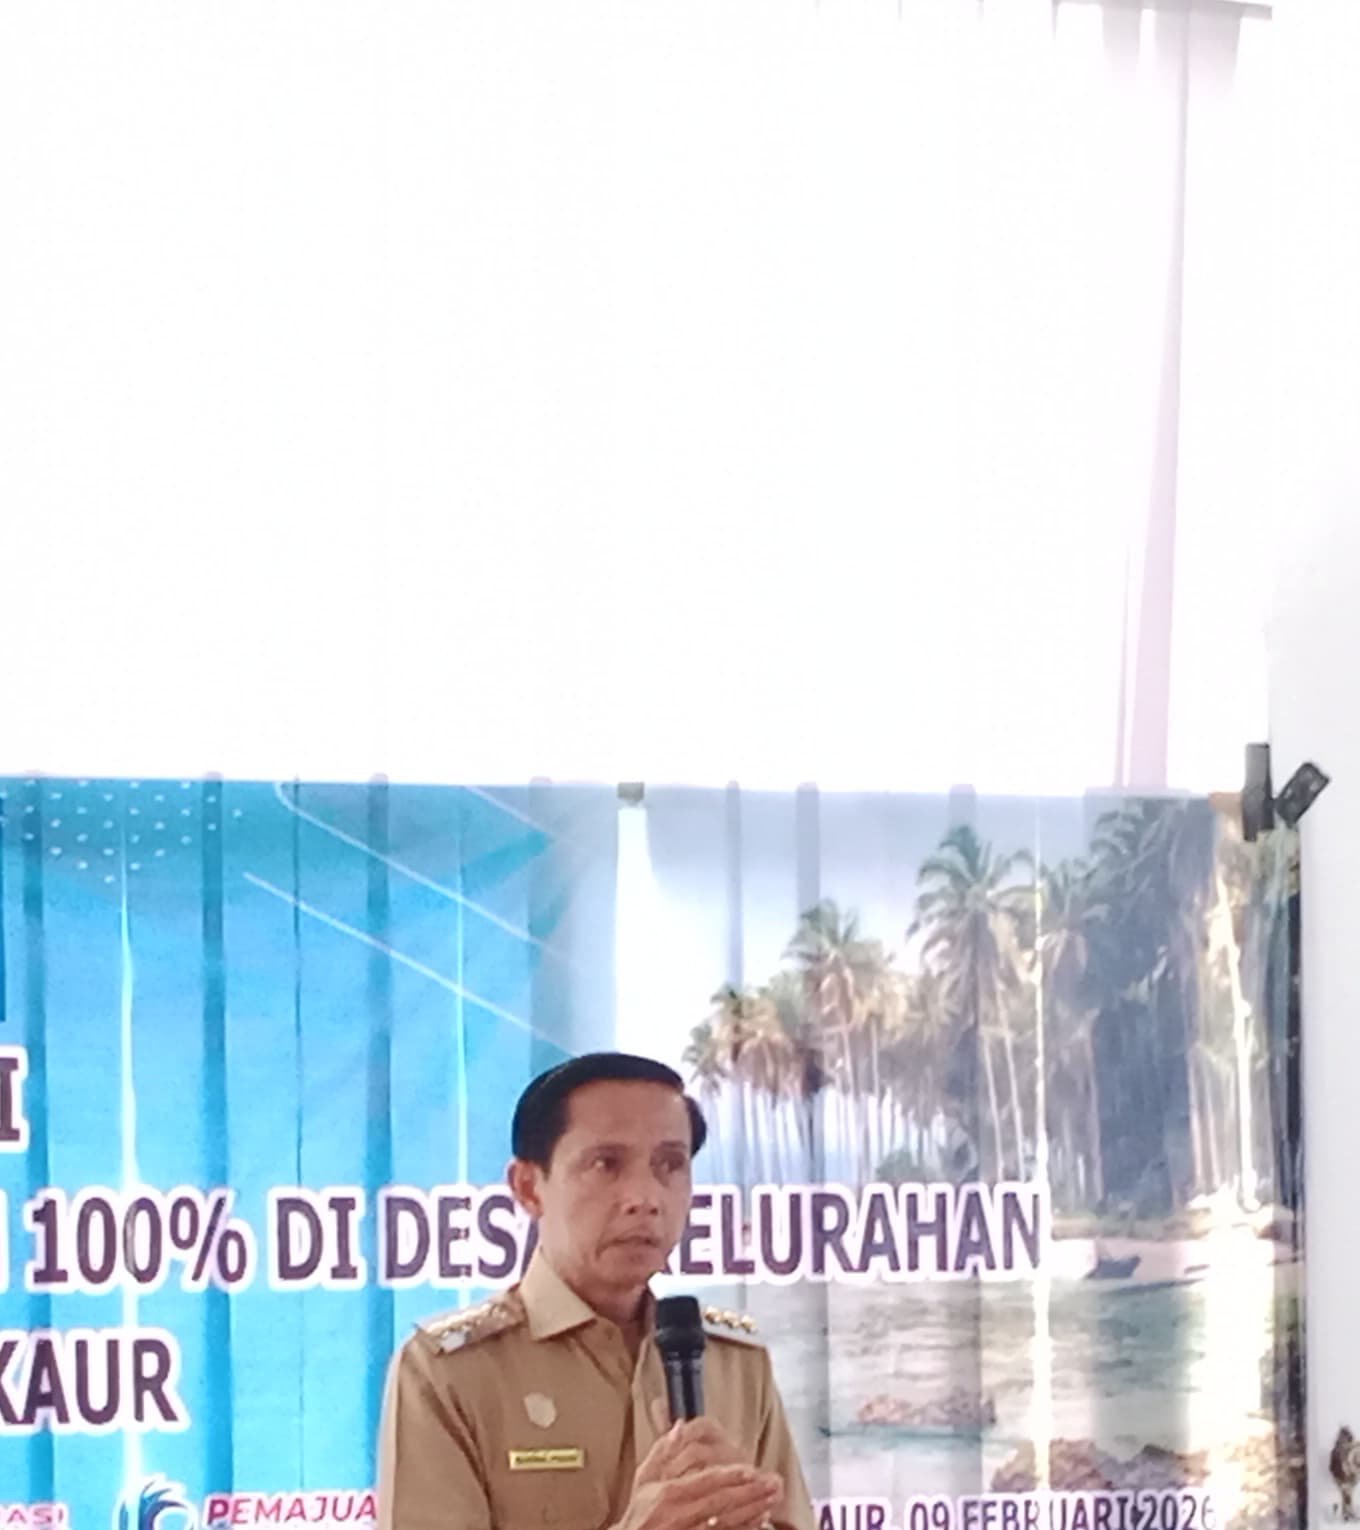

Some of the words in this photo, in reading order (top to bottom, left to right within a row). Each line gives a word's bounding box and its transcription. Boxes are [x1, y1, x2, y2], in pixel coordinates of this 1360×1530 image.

[31, 1195, 248, 1283] 100%
[276, 1195, 358, 1281] DI
[664, 1191, 1040, 1275] ELURAHAN
[206, 1494, 377, 1525] PEMAJUA
